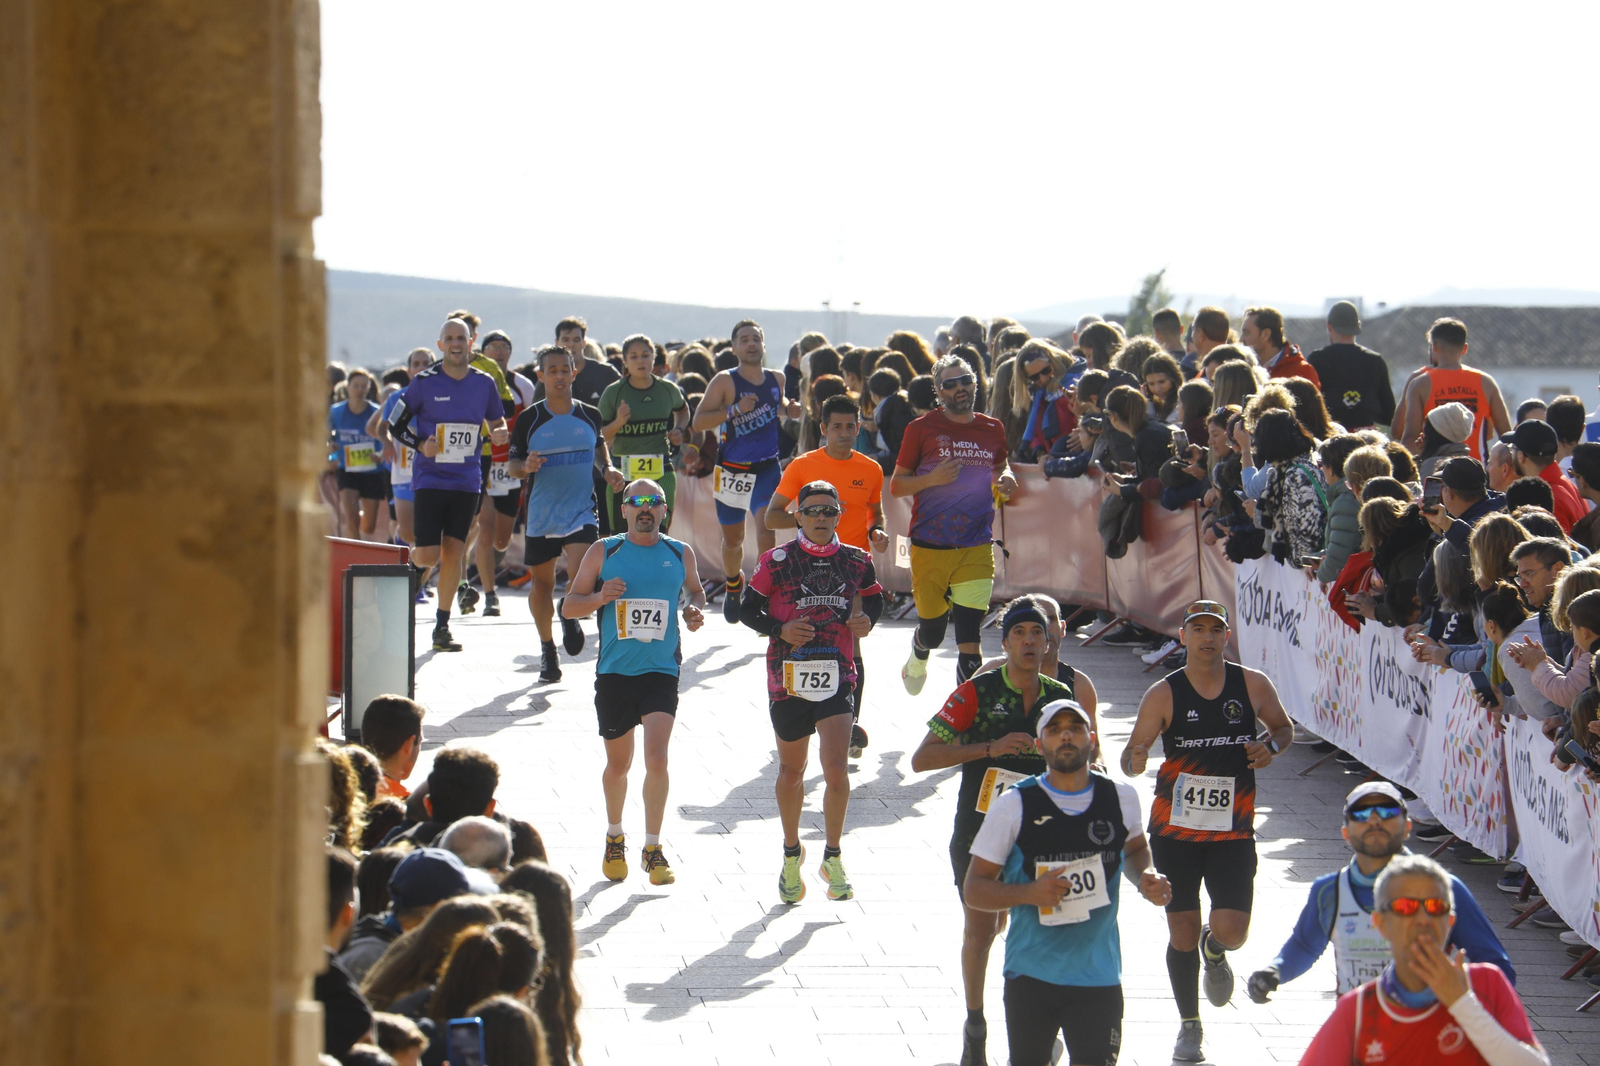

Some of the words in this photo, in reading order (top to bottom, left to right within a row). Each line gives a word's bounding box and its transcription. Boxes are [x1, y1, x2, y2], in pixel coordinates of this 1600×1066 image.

[732, 403, 771, 427] RUNNING
[449, 432, 472, 445] 570
[952, 441, 979, 450] MEDIA
[938, 448, 951, 457] 36
[953, 448, 993, 459] MARATÓN
[638, 458, 652, 471] 21
[722, 477, 752, 493] 1765
[804, 597, 841, 606] SATYSTRAIL
[631, 609, 662, 626] 974
[799, 672, 831, 688] 752
[1192, 777, 1216, 785] IMDECO
[1184, 786, 1230, 807] 4158
[1058, 869, 1096, 897] 30
